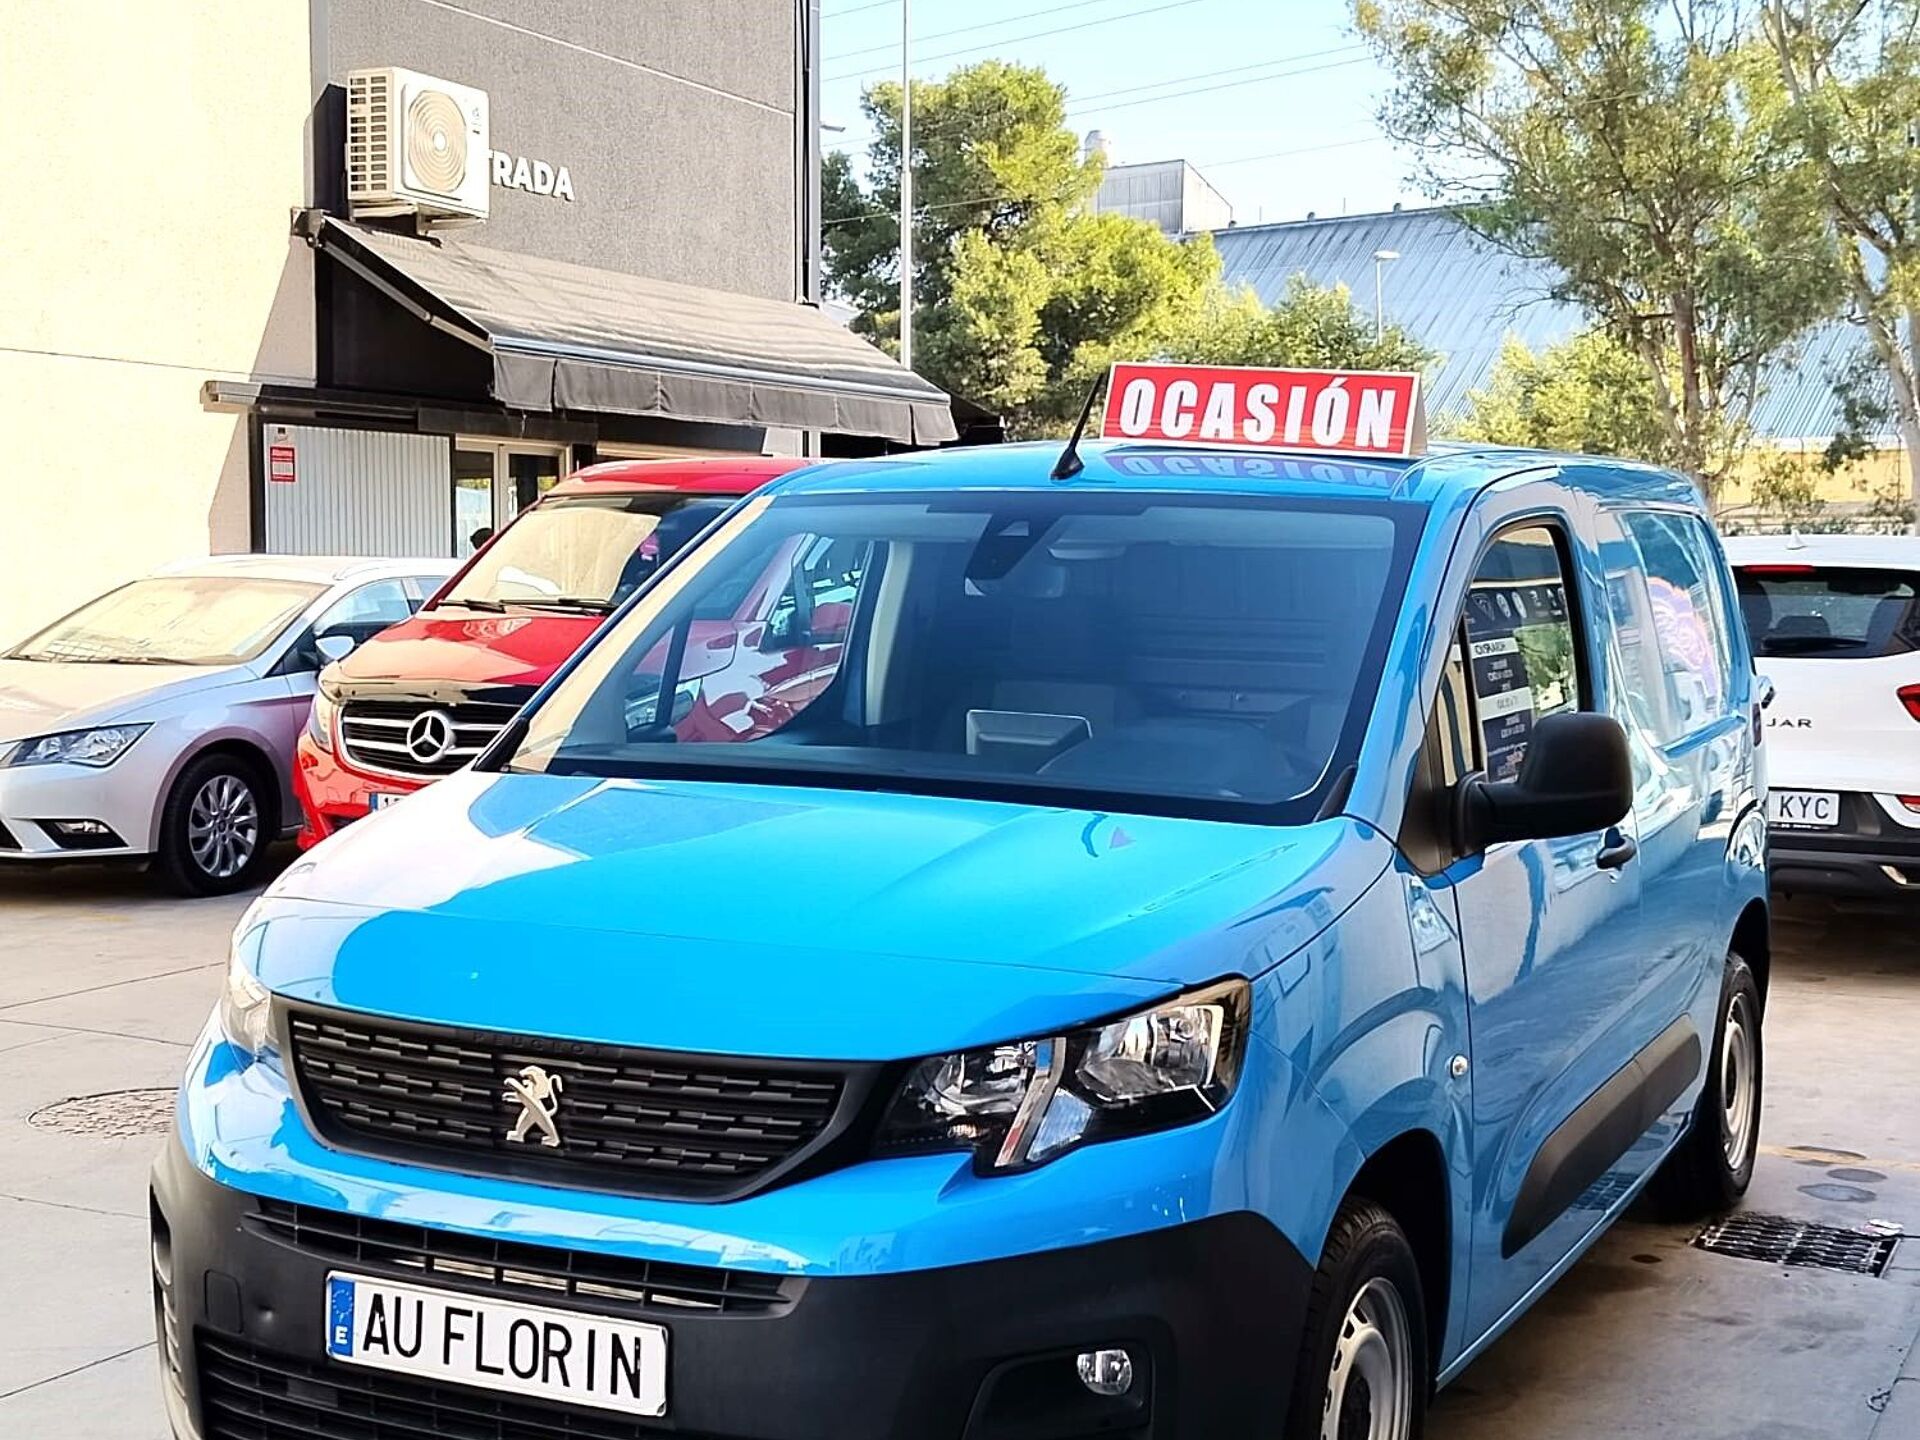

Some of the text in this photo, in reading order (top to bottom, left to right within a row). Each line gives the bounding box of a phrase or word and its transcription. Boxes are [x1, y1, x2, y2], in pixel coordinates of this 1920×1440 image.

[1119, 377, 1396, 448] OCASIÓN
[1779, 795, 1829, 819] KYC
[335, 1325, 348, 1344] E
[363, 1293, 641, 1399] AU FLORIN
